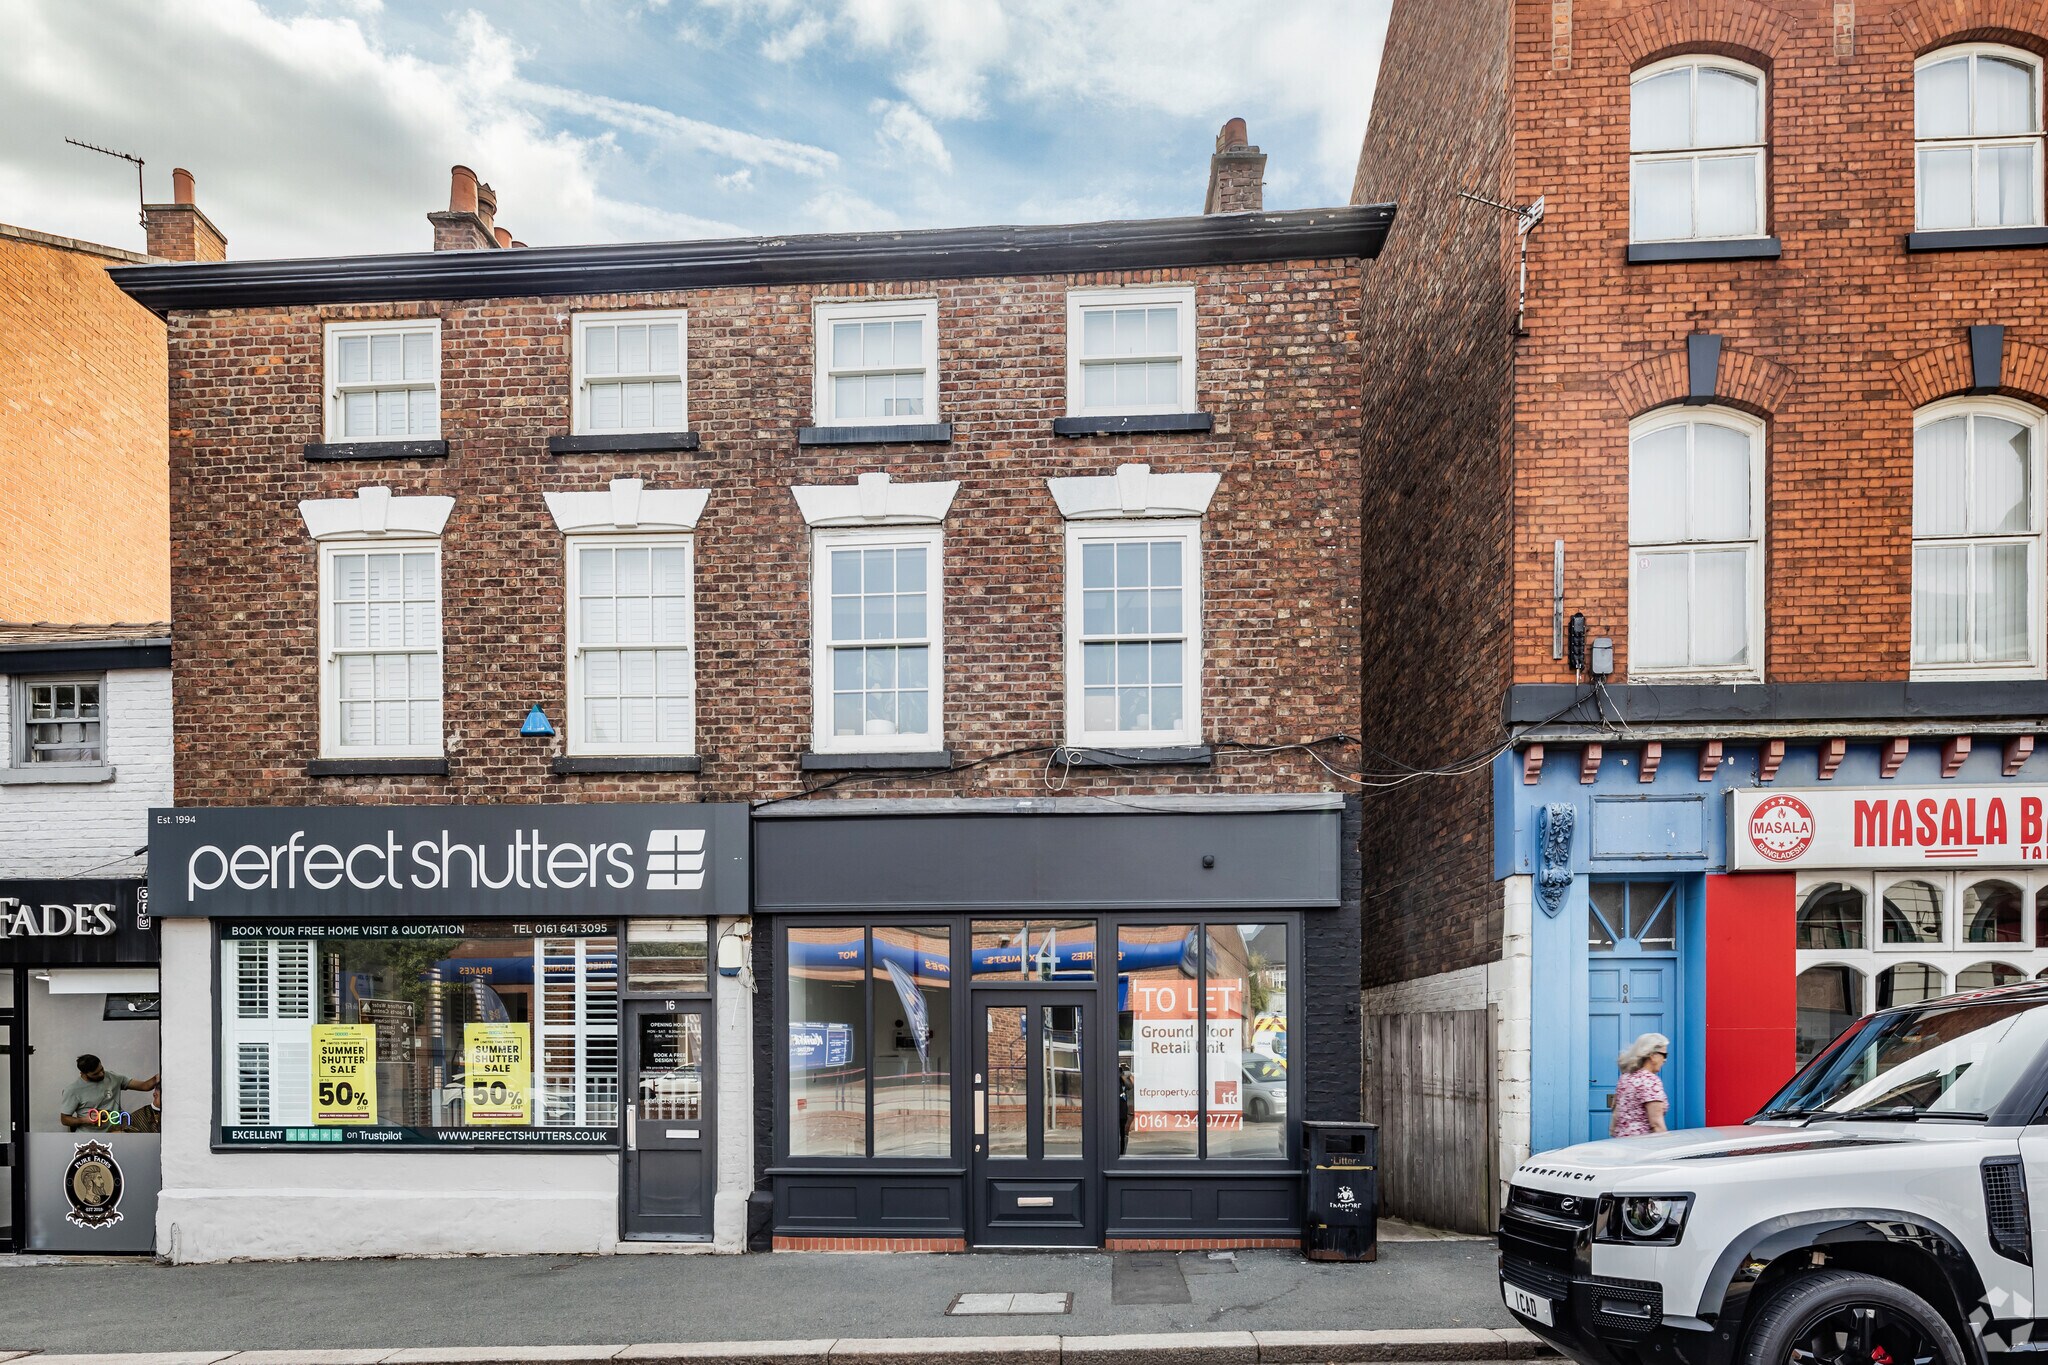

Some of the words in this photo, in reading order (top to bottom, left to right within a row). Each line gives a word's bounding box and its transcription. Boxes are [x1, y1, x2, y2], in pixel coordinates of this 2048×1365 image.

[157, 815, 173, 824] Est.
[175, 815, 196, 824] 1994
[1854, 797, 2007, 847] MASALA
[2020, 796, 2048, 845] B
[1753, 820, 1810, 835] MASALA
[1757, 841, 1806, 860] BANGLADESHI
[2020, 846, 2048, 860] TA
[188, 829, 403, 901] perfect
[410, 829, 635, 890] shutters
[0, 897, 117, 940] FADES
[231, 926, 263, 936] BOOK
[265, 926, 295, 936] YOUR
[298, 926, 325, 936] FREE
[328, 925, 359, 936] HOME
[361, 925, 389, 935] VISIT
[391, 925, 399, 935] &
[401, 924, 465, 935] QUOTATION
[512, 924, 532, 934] TEL
[535, 923, 558, 934] 0161
[560, 923, 578, 934] 641
[580, 923, 608, 933] 3095
[1012, 927, 1061, 974] 14
[665, 1000, 676, 1011] 16
[1138, 986, 1176, 1013] TO
[1187, 986, 1236, 1012] LET
[1141, 1024, 1194, 1038] Ground
[1206, 1026, 1235, 1038] loor
[321, 1046, 365, 1055] SUMMER
[475, 1045, 519, 1054] SUMMER
[1151, 1041, 1191, 1054] Retail
[1196, 1041, 1225, 1054] nit
[321, 1056, 366, 1064] SHUTTER
[475, 1055, 520, 1063] SHUTTER
[330, 1065, 357, 1074] SALE
[484, 1064, 511, 1073] SALE
[319, 1081, 369, 1106] 50%
[473, 1080, 523, 1106] 50%
[1139, 1088, 1209, 1099] tfcproperty.co
[87, 1107, 131, 1127] open
[1139, 1113, 1168, 1128] 0161
[1174, 1113, 1199, 1128] 234
[1206, 1113, 1237, 1128] 0777
[232, 1130, 283, 1140] EXCELLENT
[346, 1131, 358, 1139] on
[359, 1130, 403, 1142] Trustpilot
[437, 1131, 607, 1141] WWW.PERFECTSHUTTERS.CO.UK
[75, 1156, 92, 1169] PURE
[93, 1155, 112, 1169] FADES
[1332, 1156, 1357, 1165] Litter
